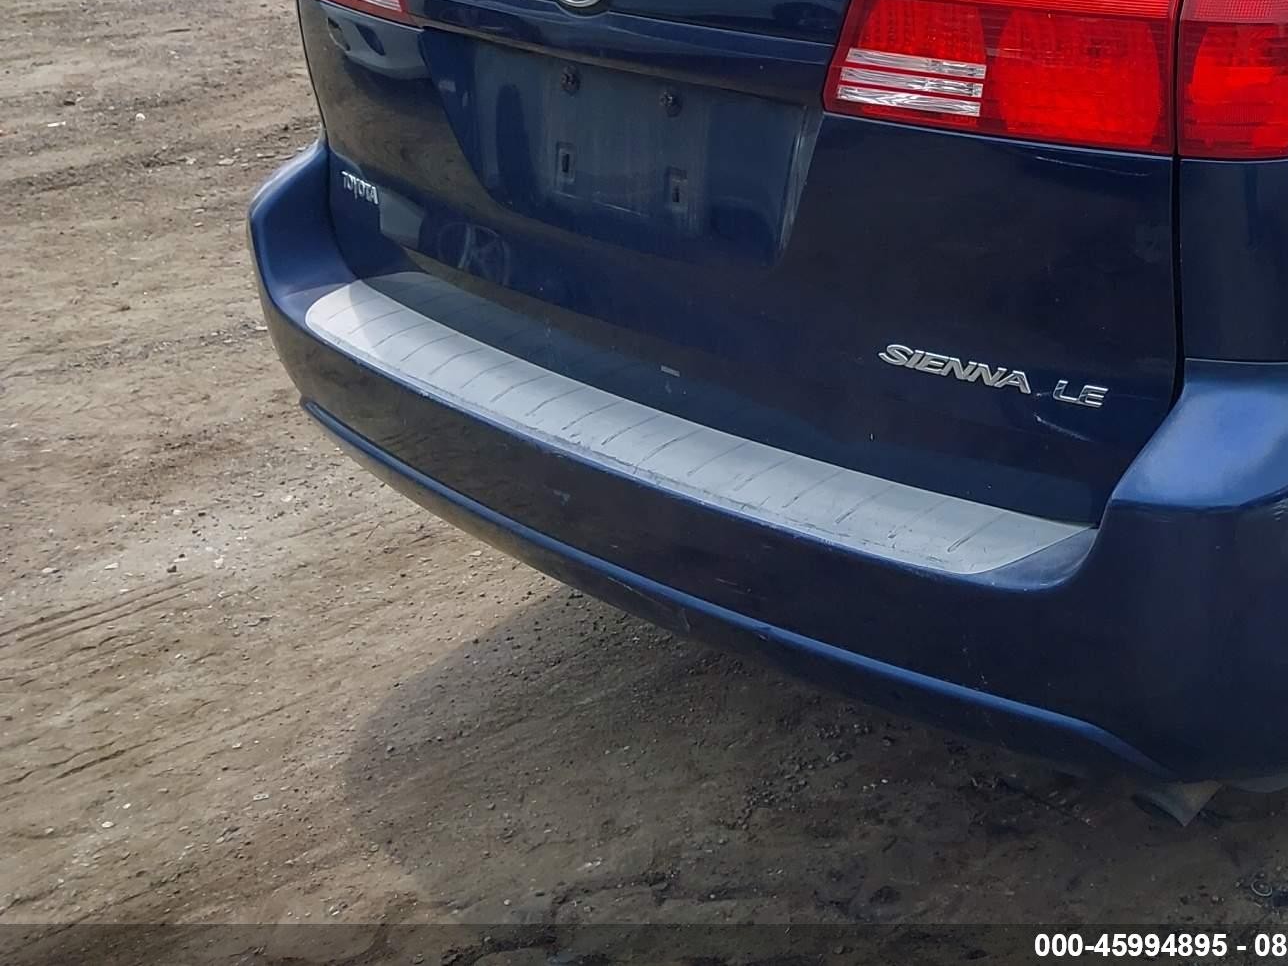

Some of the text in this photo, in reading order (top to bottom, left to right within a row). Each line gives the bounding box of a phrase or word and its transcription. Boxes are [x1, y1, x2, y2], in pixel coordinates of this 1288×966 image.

[341, 170, 379, 205] TOYOTA
[878, 343, 1109, 408] SIENNA LE
